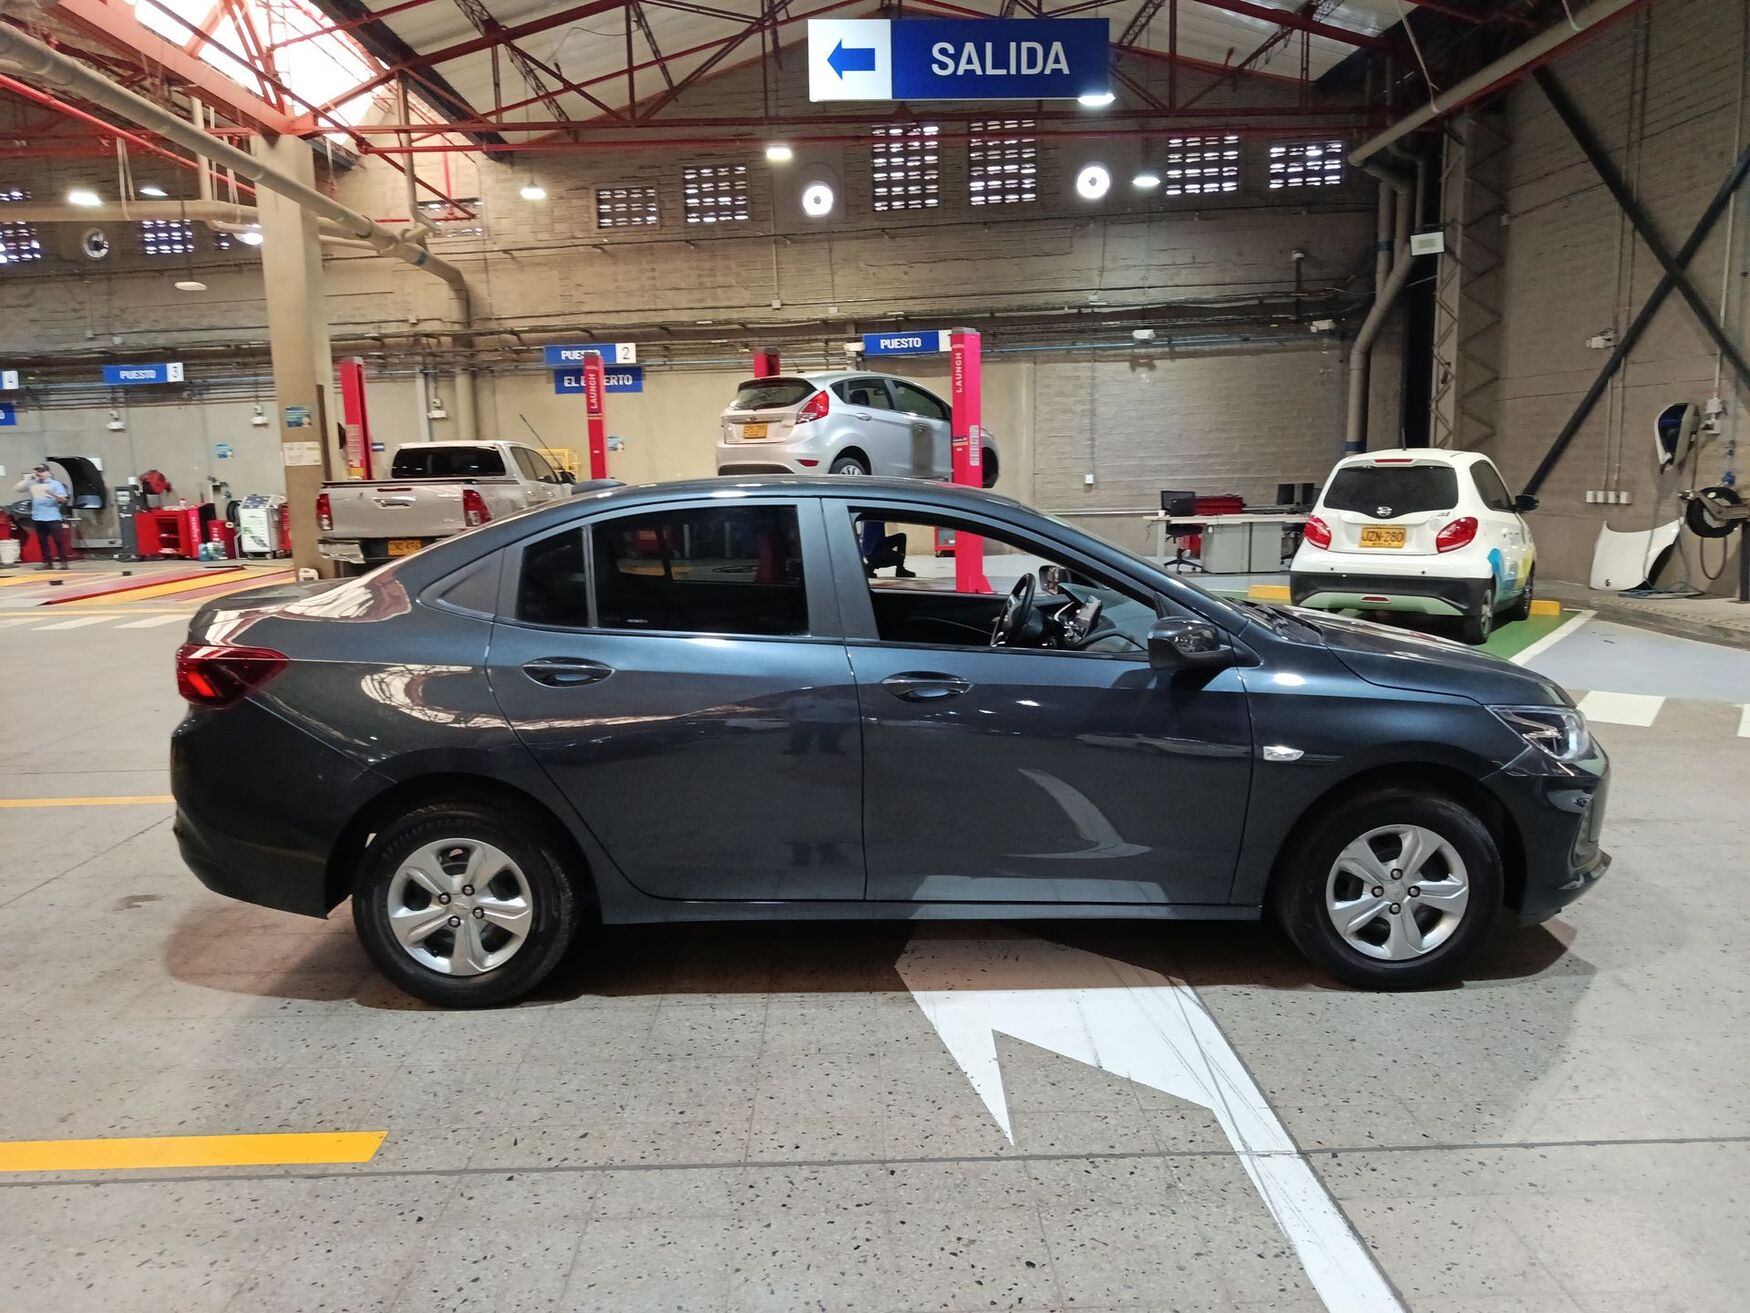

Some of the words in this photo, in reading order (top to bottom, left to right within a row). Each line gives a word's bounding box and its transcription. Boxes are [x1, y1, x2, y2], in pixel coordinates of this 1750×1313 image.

[931, 41, 1070, 76] SALIDA
[621, 346, 631, 360] 2
[880, 337, 922, 350] PUESTO
[563, 376, 580, 387] EL
[955, 352, 964, 394] LAUNCH
[588, 373, 599, 410] LAUNCH
